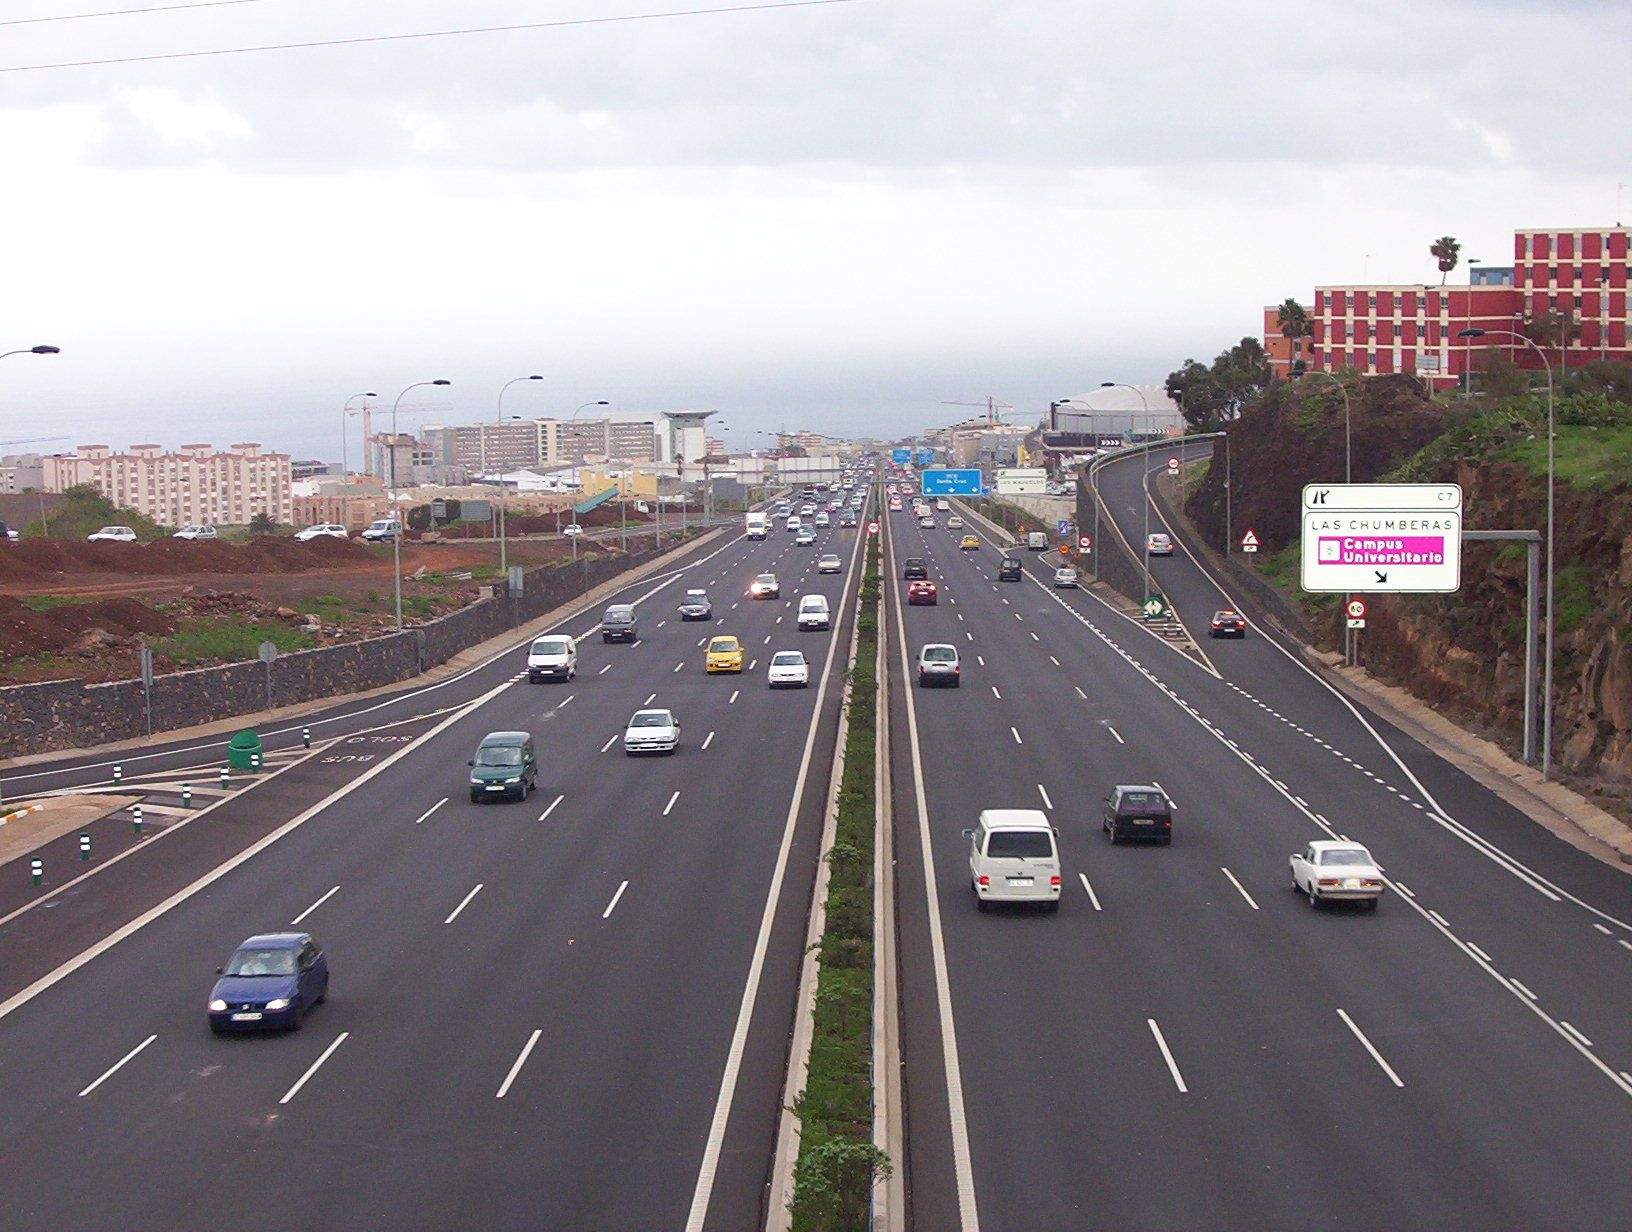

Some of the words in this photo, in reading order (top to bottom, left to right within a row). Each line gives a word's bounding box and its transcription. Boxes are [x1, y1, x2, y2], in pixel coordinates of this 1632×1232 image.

[1311, 520, 1341, 530] LAS
[1349, 520, 1452, 530] CHUMBERAS
[1343, 538, 1404, 551] Campus
[1343, 552, 1443, 563] Universitario
